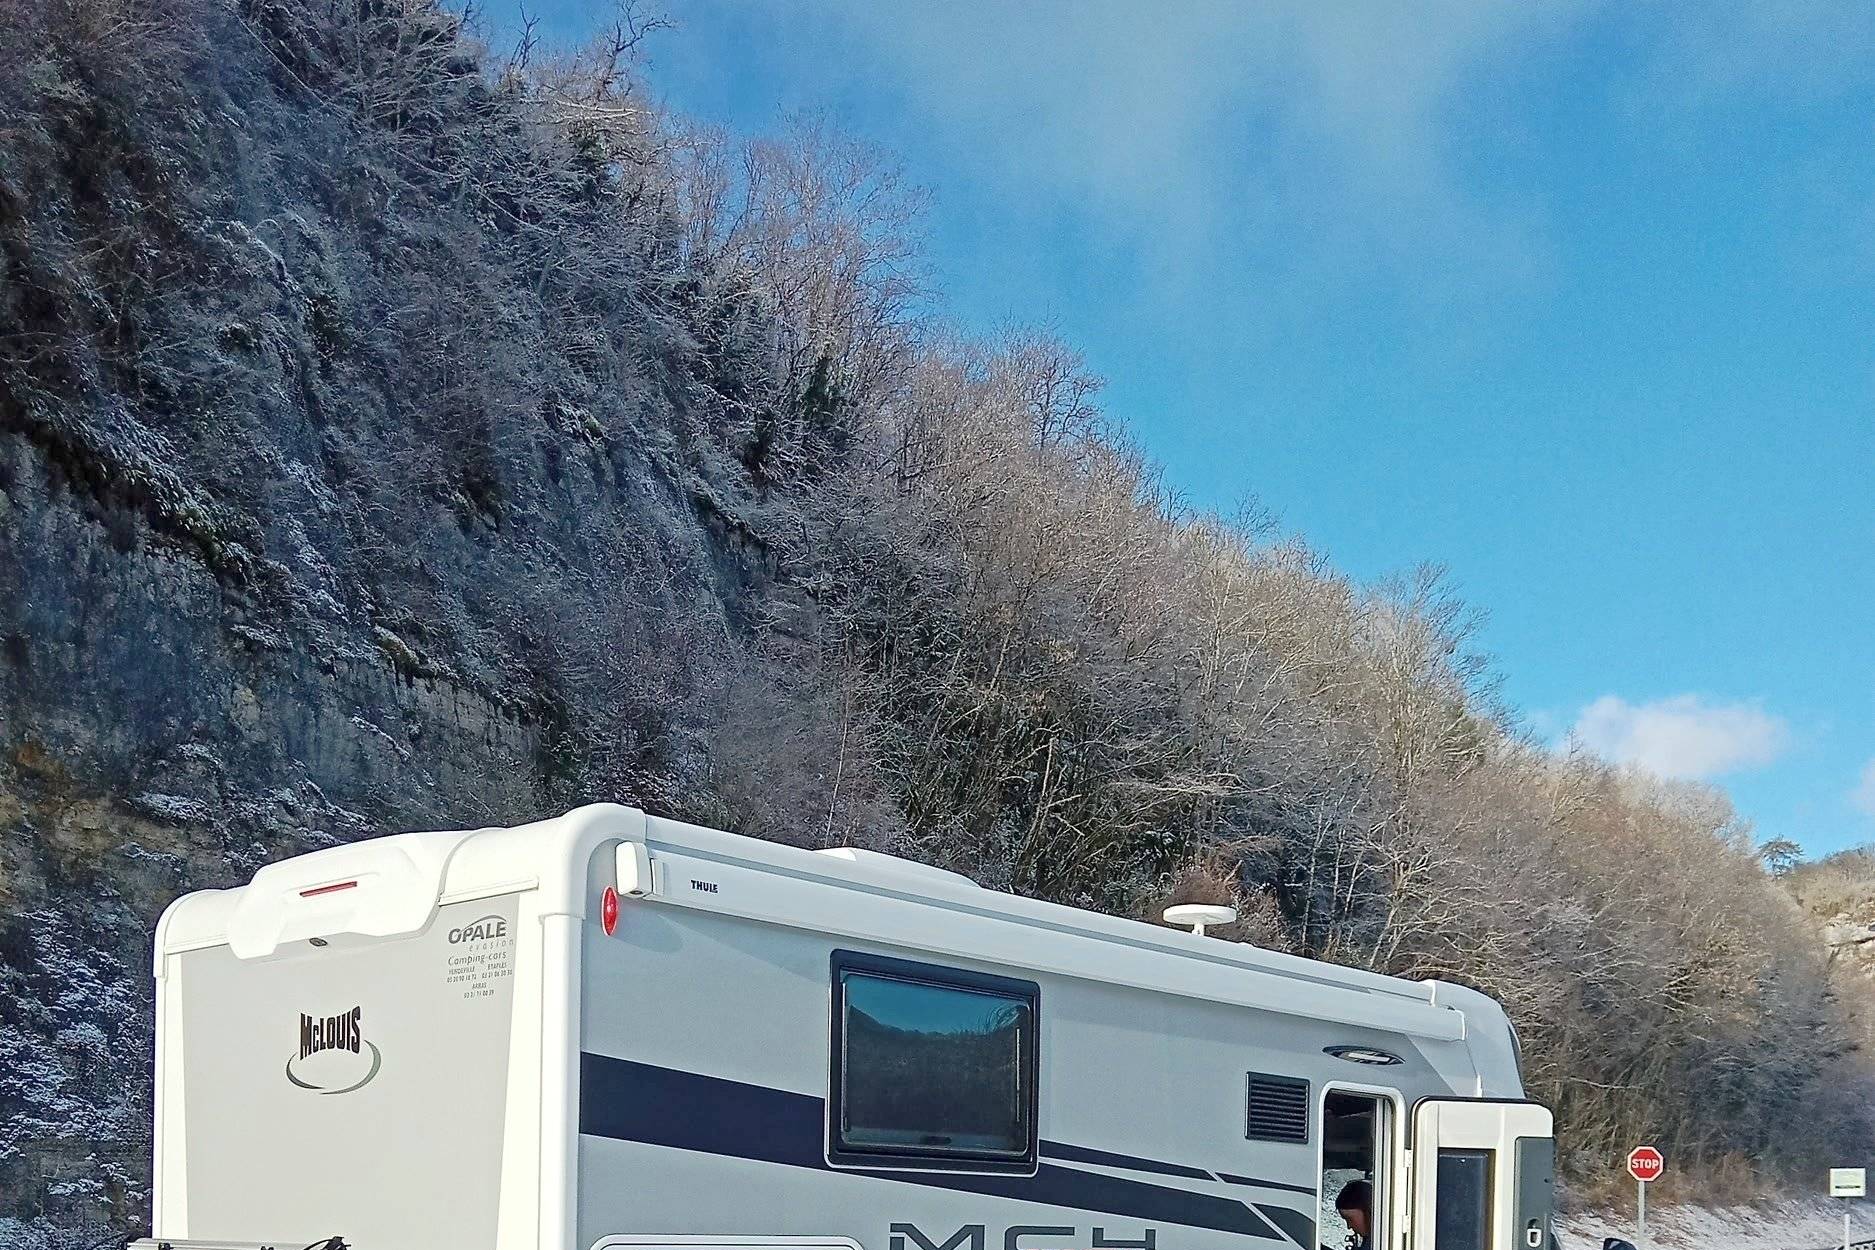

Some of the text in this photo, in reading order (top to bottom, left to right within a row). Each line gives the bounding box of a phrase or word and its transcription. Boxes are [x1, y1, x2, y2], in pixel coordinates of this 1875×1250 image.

[690, 879, 718, 894] THULE
[448, 921, 507, 944] OPALE
[1631, 1158, 1660, 1169] STOP
